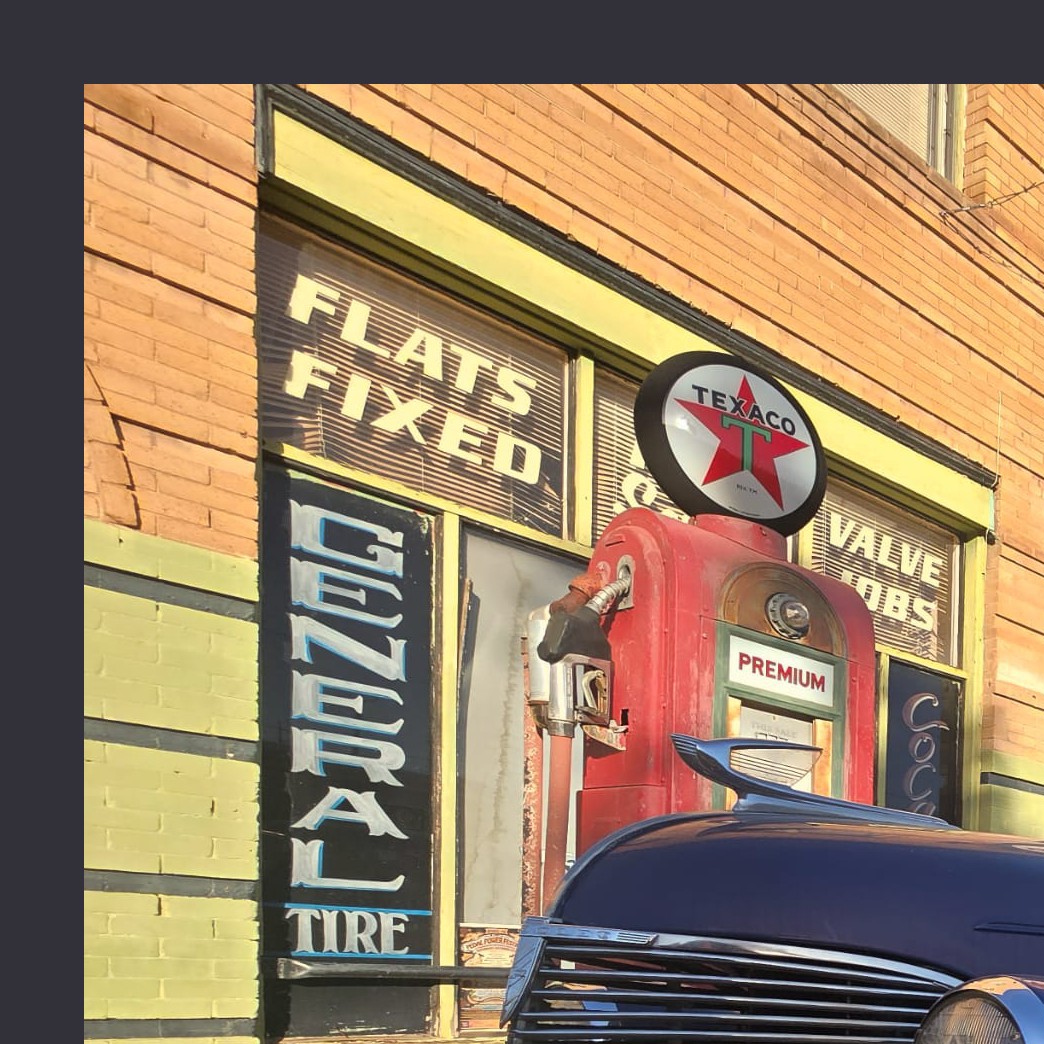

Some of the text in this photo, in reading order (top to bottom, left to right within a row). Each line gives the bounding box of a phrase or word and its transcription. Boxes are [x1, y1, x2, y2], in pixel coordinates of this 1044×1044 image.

[284, 273, 537, 417] FLATS
[283, 350, 543, 486] FIXED
[691, 384, 796, 436] TEXACO
[721, 414, 773, 472] T
[829, 512, 943, 587] VALVE
[289, 498, 408, 892] GENERAL
[738, 651, 826, 692] PREMIUM
[284, 908, 410, 957] TIRE
